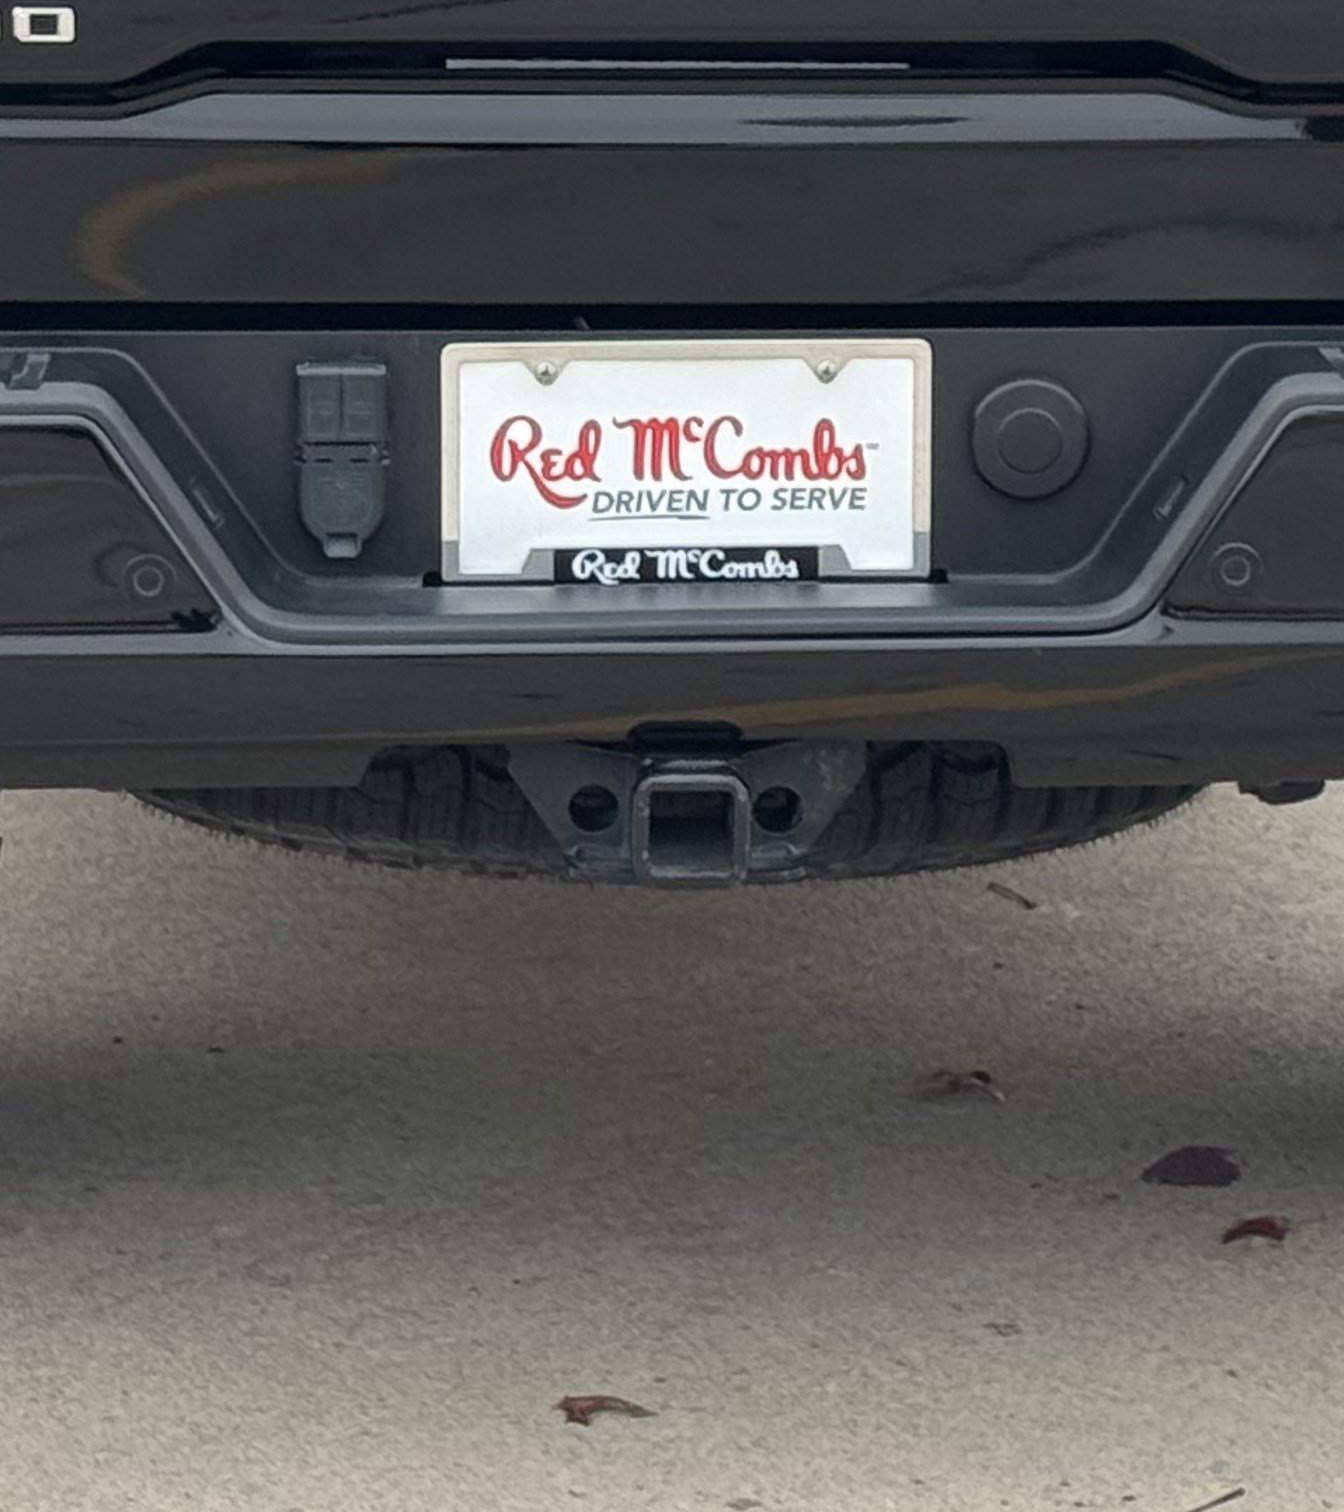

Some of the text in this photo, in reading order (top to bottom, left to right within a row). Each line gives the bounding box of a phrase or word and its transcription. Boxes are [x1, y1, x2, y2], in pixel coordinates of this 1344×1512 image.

[490, 415, 868, 509] Red McCombs
[592, 488, 868, 514] DRIVEN TO SERVE
[571, 548, 800, 585] Red McCombs
